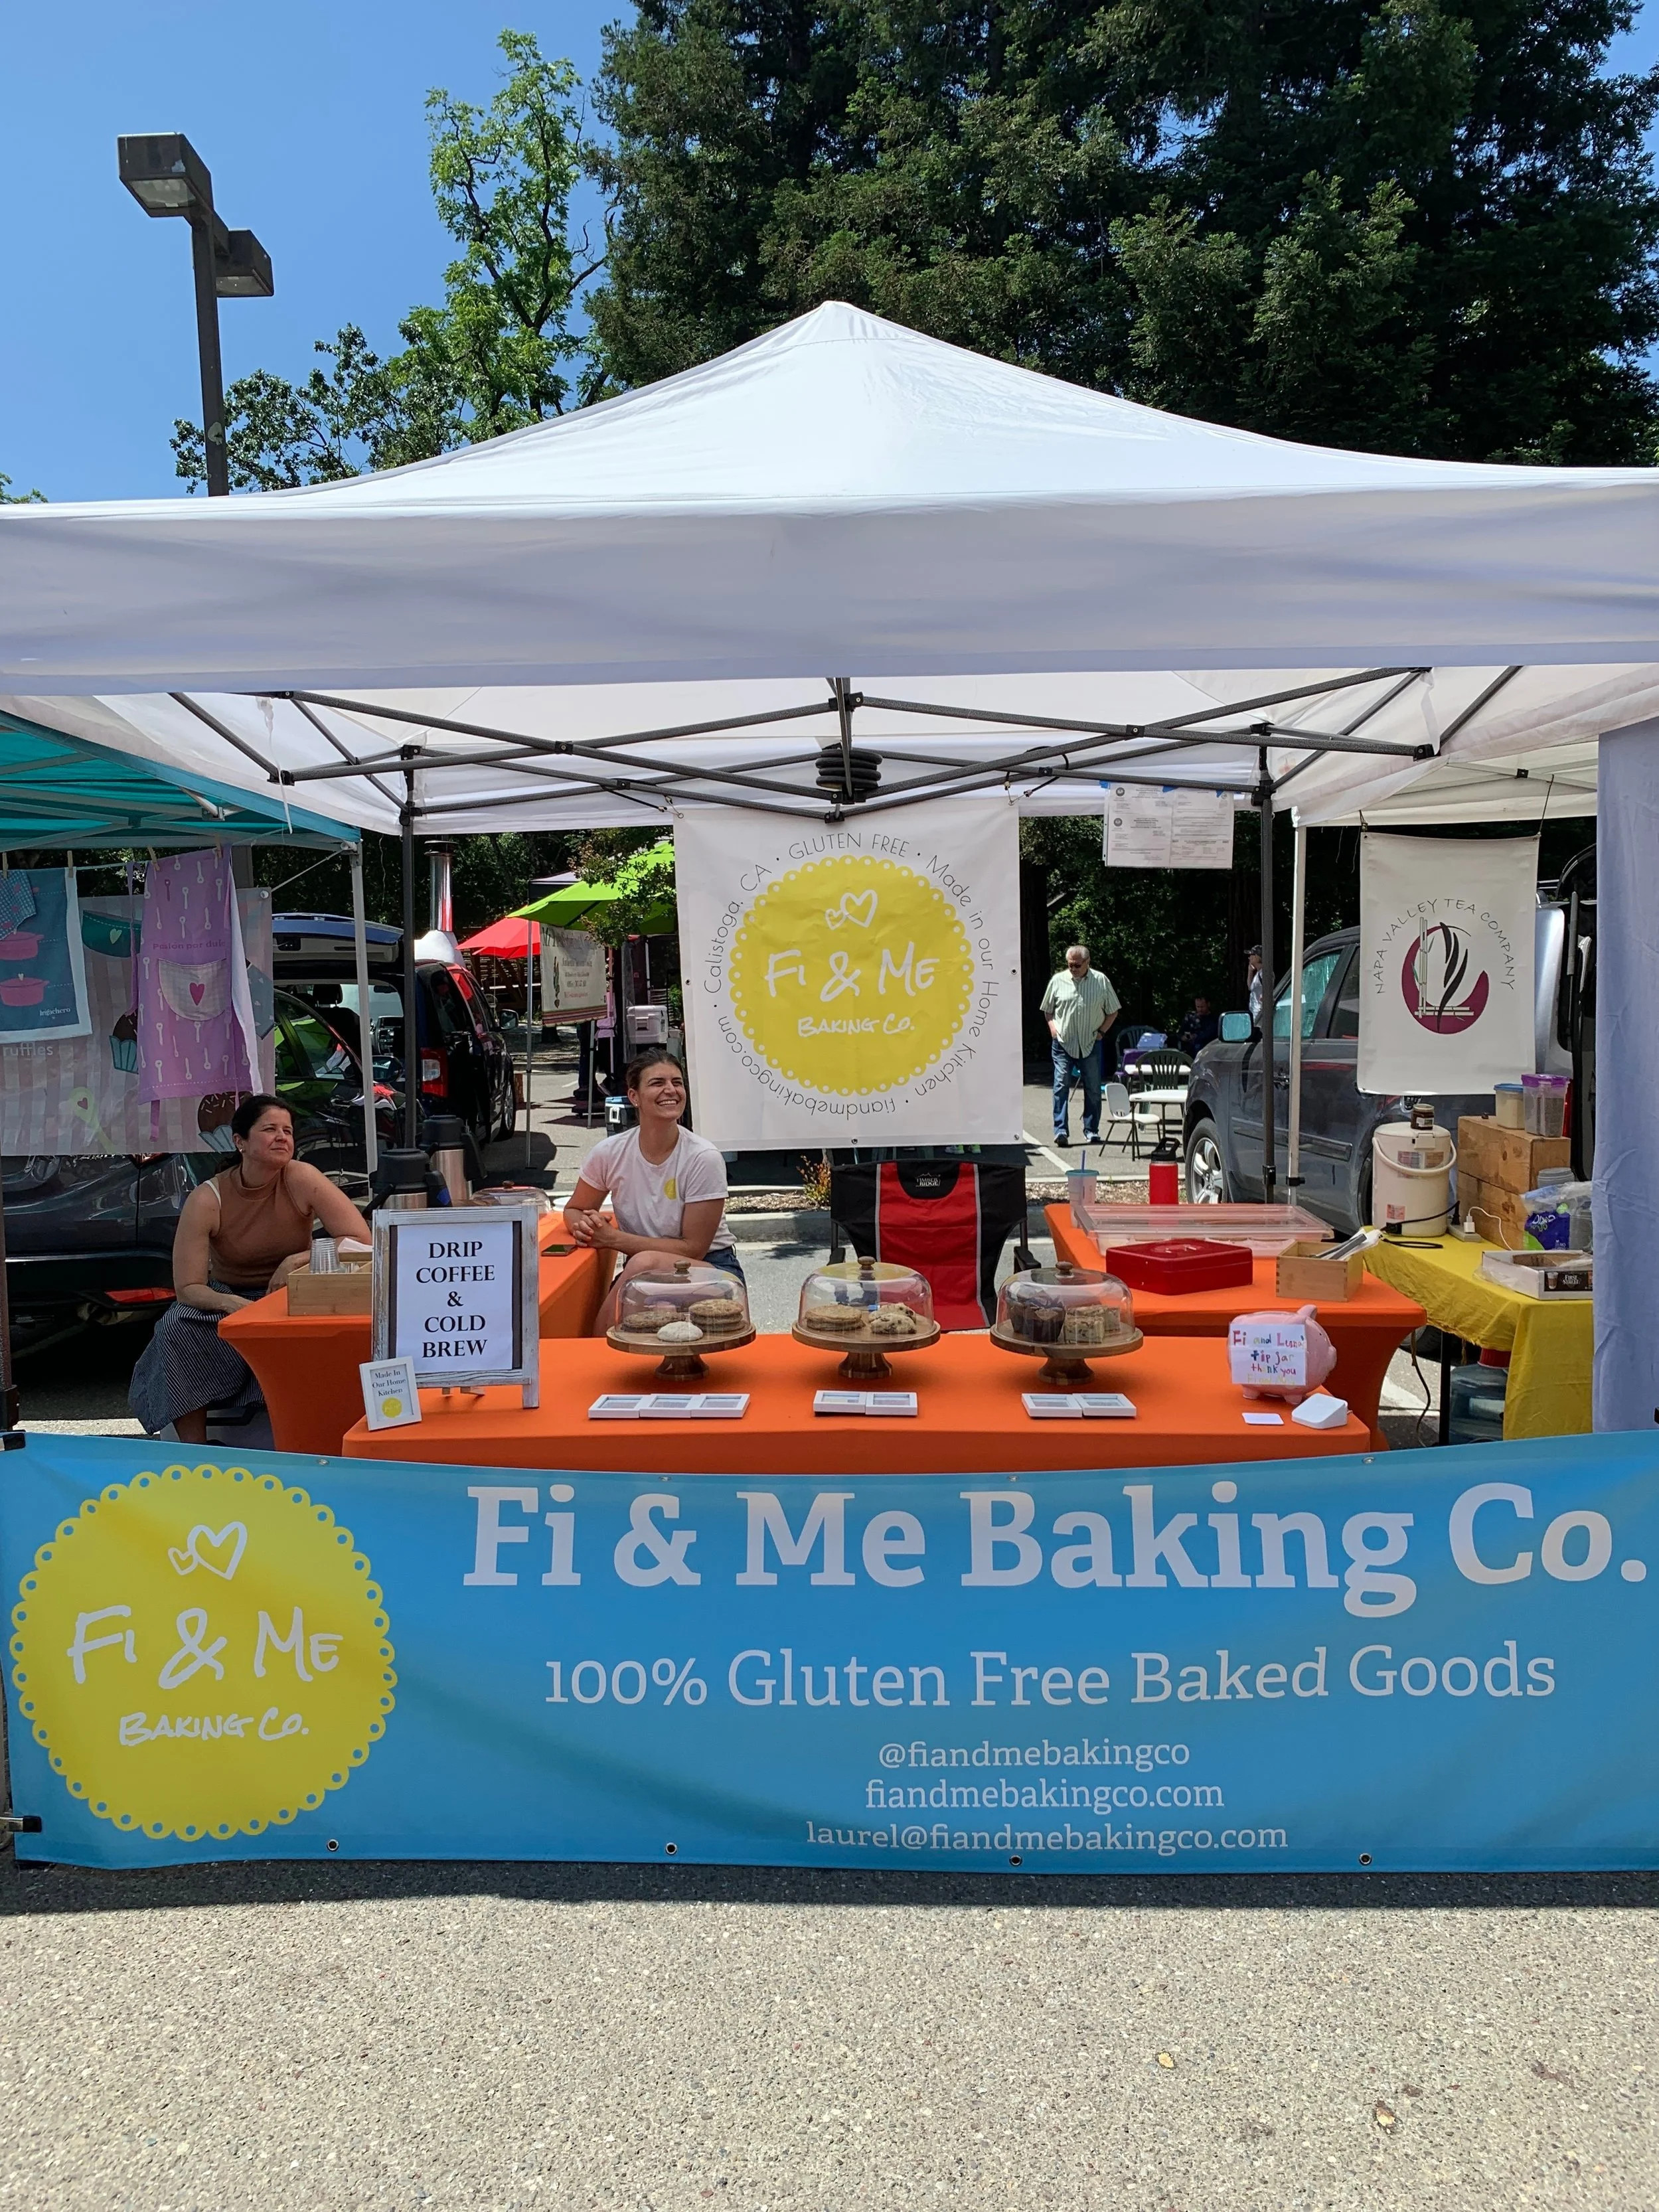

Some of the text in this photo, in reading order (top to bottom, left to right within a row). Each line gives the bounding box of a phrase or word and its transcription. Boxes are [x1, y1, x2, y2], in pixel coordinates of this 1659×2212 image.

[789, 832, 910, 859] GLUTEN FREE
[740, 864, 772, 892] CA
[1373, 898, 1516, 994] NAPA VALLEY TEA COMPANY
[819, 951, 861, 1002] &
[915, 854, 999, 1097] Made in our Home Kitchen
[797, 1016, 880, 1038] BAKING
[718, 1015, 896, 1120] fiandmebakingco.com
[428, 1241, 483, 1259] DRIP
[416, 1265, 495, 1283] COFFEE
[447, 1291, 464, 1307] &
[424, 1314, 486, 1332] COLD
[422, 1339, 488, 1358] BREW
[1233, 1330, 1247, 1346] Fi
[1253, 1334, 1271, 1344] and
[1251, 1350, 1295, 1365] tip jar
[1281, 1368, 1296, 1377] you
[378, 1387, 403, 1397] Kitchen
[463, 1480, 1648, 1619] Fi & Me Baking Co.
[158, 1608, 228, 1690] &
[545, 1640, 1556, 1707] 100% Gluten Free Baked Goods
[119, 1711, 254, 1747] BAKING
[878, 1737, 1190, 1773] @fiandmebakingco
[865, 1777, 1225, 1815] fiandmebakingco.com
[806, 1821, 1289, 1856] laurel@fiandmebakingco.com
